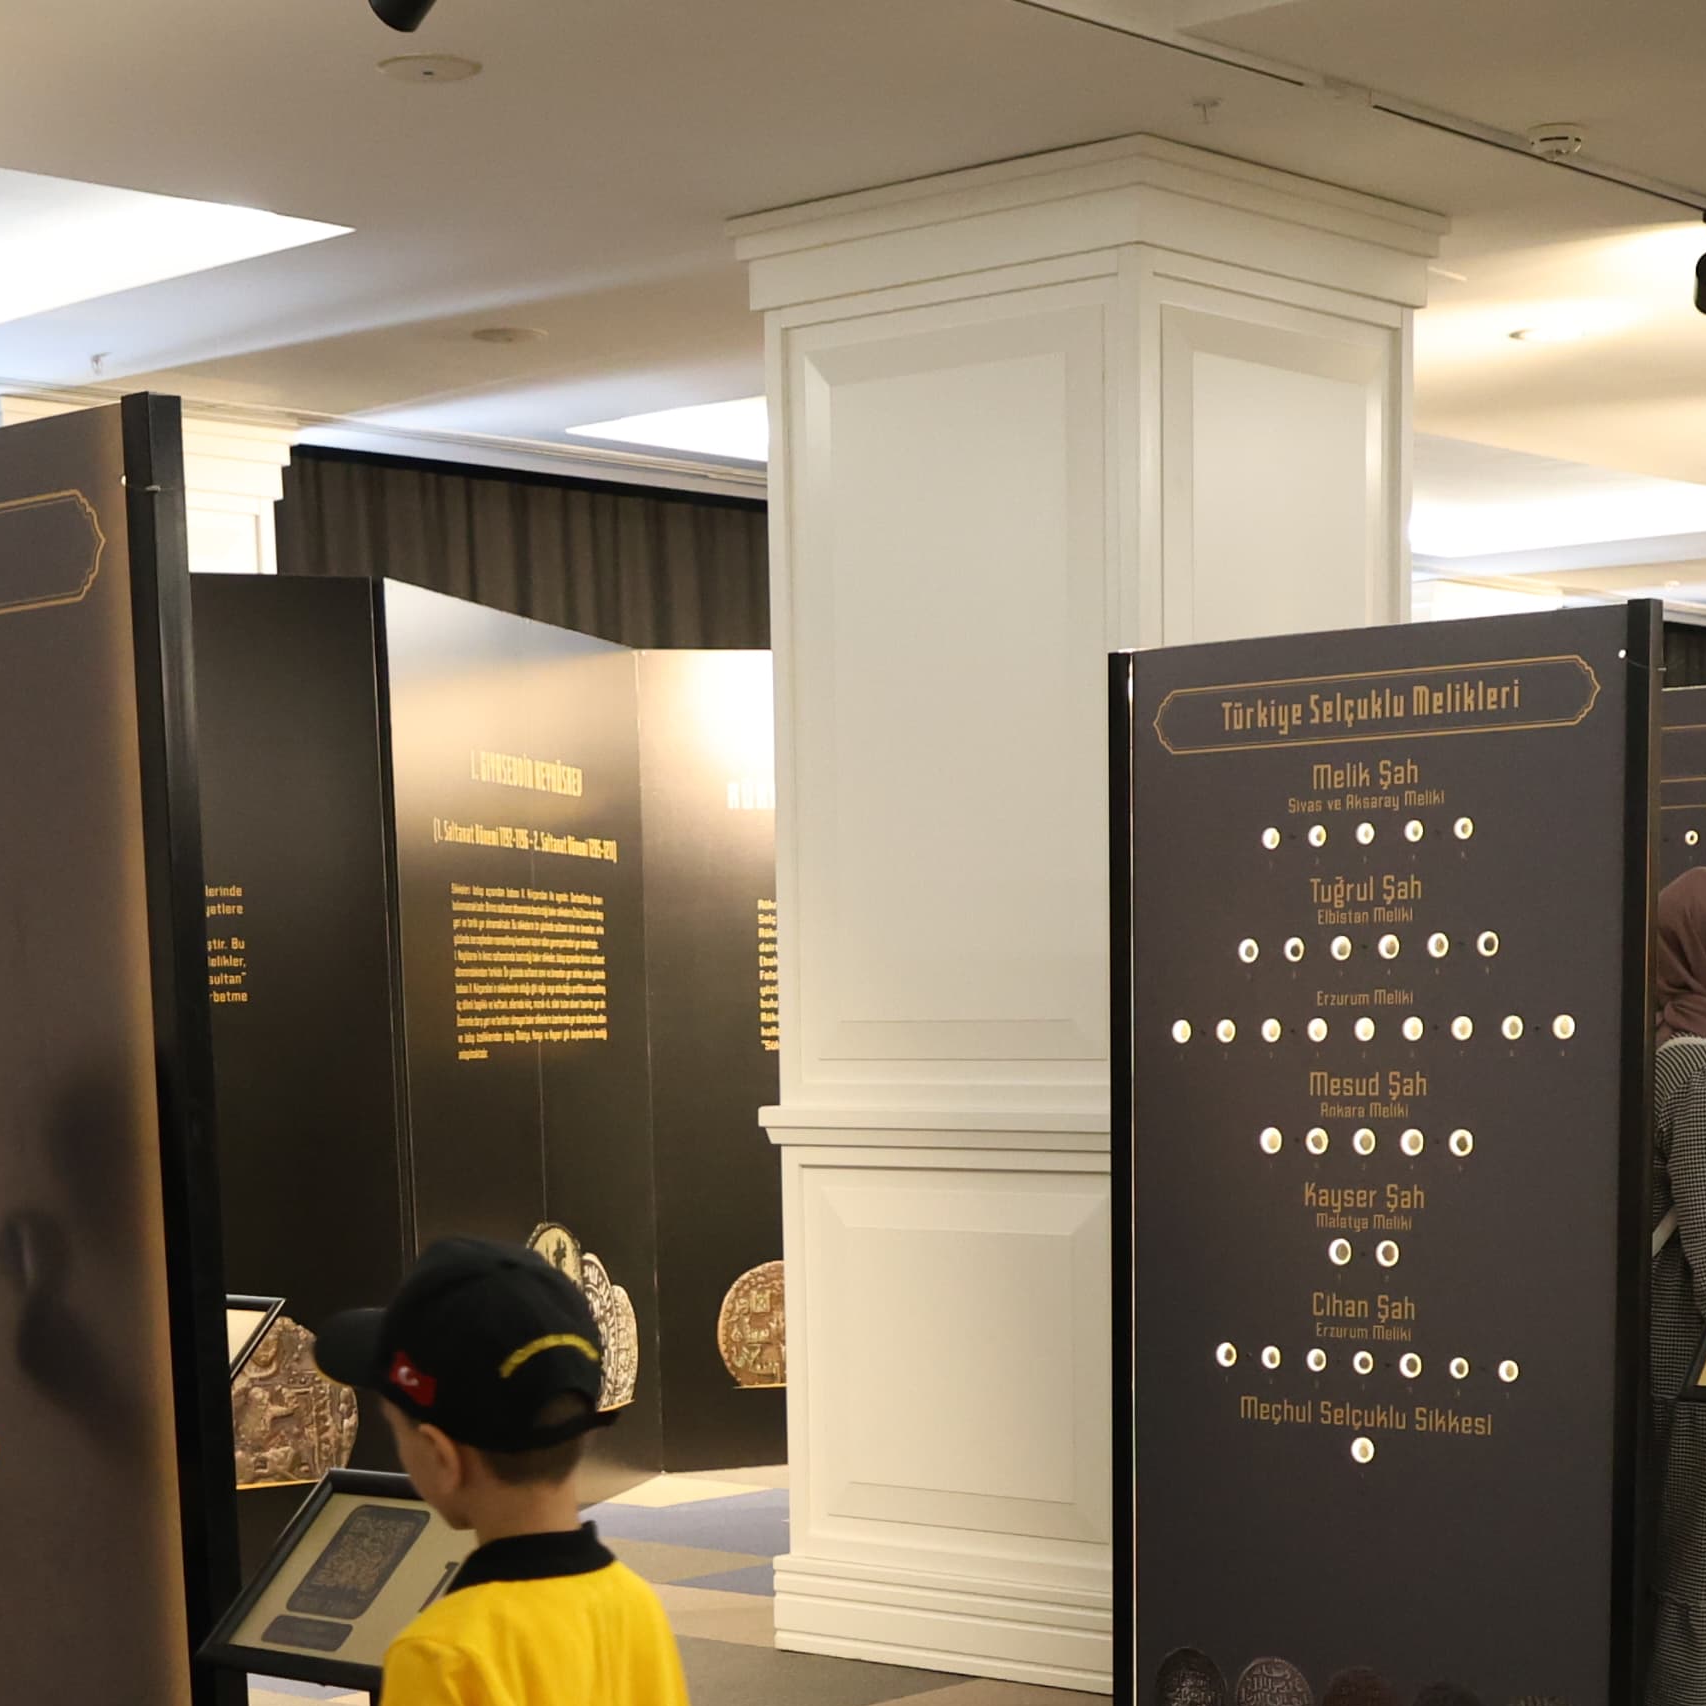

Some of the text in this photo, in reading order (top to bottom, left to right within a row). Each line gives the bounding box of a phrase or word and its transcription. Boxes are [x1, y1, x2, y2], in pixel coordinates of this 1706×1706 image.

[1222, 679, 1521, 735] Türkiye Selçuklu Melikleri
[1313, 758, 1419, 790] Melik Şah
[1288, 789, 1445, 814] Sivas ve Aksaray Meliki
[1310, 874, 1422, 910] Tuğrul Şah
[1318, 907, 1413, 925] Elbistan Meliki
[1317, 989, 1414, 1006] Erzurum Meliki
[1309, 1071, 1428, 1101] Mesud Şah
[1321, 1102, 1409, 1119] Ankara Meliki
[1304, 1182, 1425, 1213] Kayser Şah
[1316, 1213, 1412, 1232] Malatya Meliki
[1313, 1292, 1416, 1323] Cihan Şah
[1316, 1322, 1412, 1342] Erzurum Meliki
[1240, 1396, 1492, 1437] Meçhul Selçuklu Sikkesi
